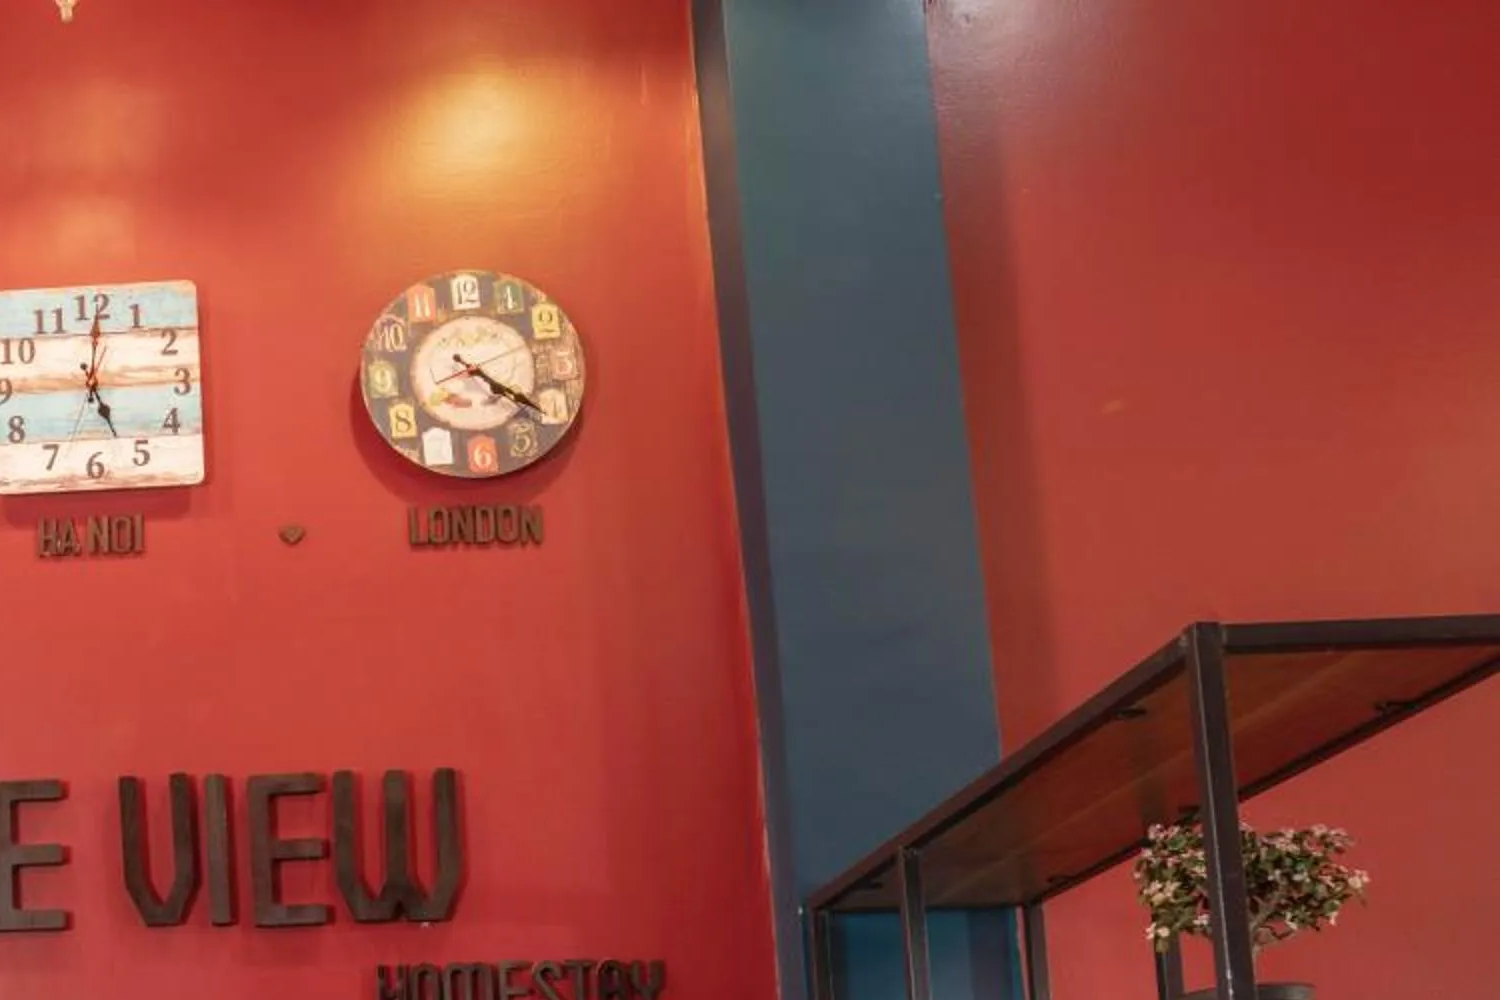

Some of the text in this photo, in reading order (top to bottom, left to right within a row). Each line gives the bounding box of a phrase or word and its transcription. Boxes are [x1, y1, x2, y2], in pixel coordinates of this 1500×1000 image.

[74, 293, 111, 321] 12
[129, 303, 144, 329] 1
[33, 308, 67, 335] 11
[0, 337, 36, 365] 10
[161, 329, 179, 356] 2
[173, 368, 192, 396] 3
[7, 415, 26, 443] 8
[161, 407, 181, 434] 4
[42, 443, 60, 470] 7
[86, 452, 105, 479] 6
[132, 440, 150, 466] 5
[408, 505, 545, 549] LONDON
[119, 767, 466, 928] VIEW
